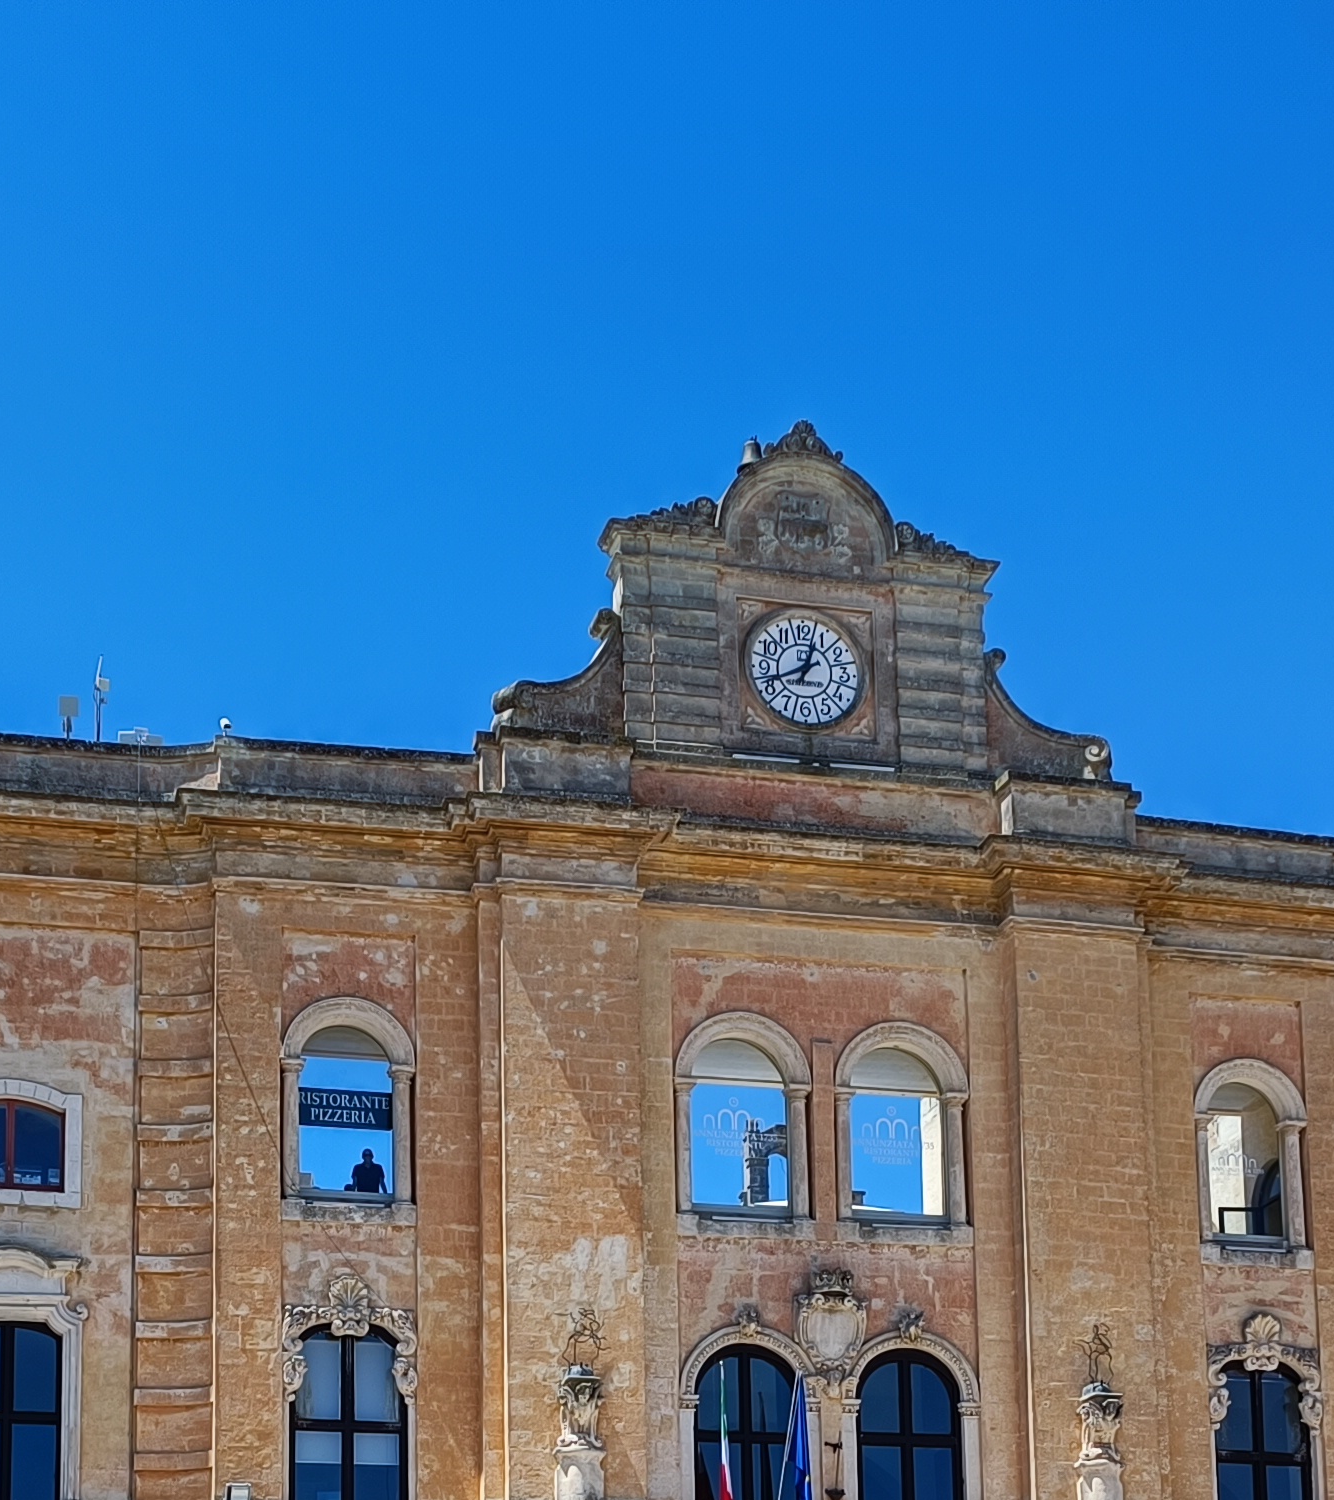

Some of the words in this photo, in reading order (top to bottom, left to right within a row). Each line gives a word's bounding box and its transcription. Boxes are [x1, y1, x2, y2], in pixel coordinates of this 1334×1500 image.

[778, 627, 789, 644] 11
[795, 624, 811, 641] 12
[818, 632, 825, 649] 1
[761, 639, 778, 656] 10
[832, 646, 843, 662] 2
[758, 659, 771, 675] 9
[838, 666, 851, 683] 3
[764, 679, 776, 695] 8
[832, 685, 843, 702] 4
[781, 694, 792, 711] 7
[799, 701, 812, 717] 6
[820, 698, 832, 715] 5
[299, 1092, 390, 1110] RISTORANTE
[310, 1107, 377, 1124] PIZZERIA
[871, 1155, 913, 1166] PIZZERIA
